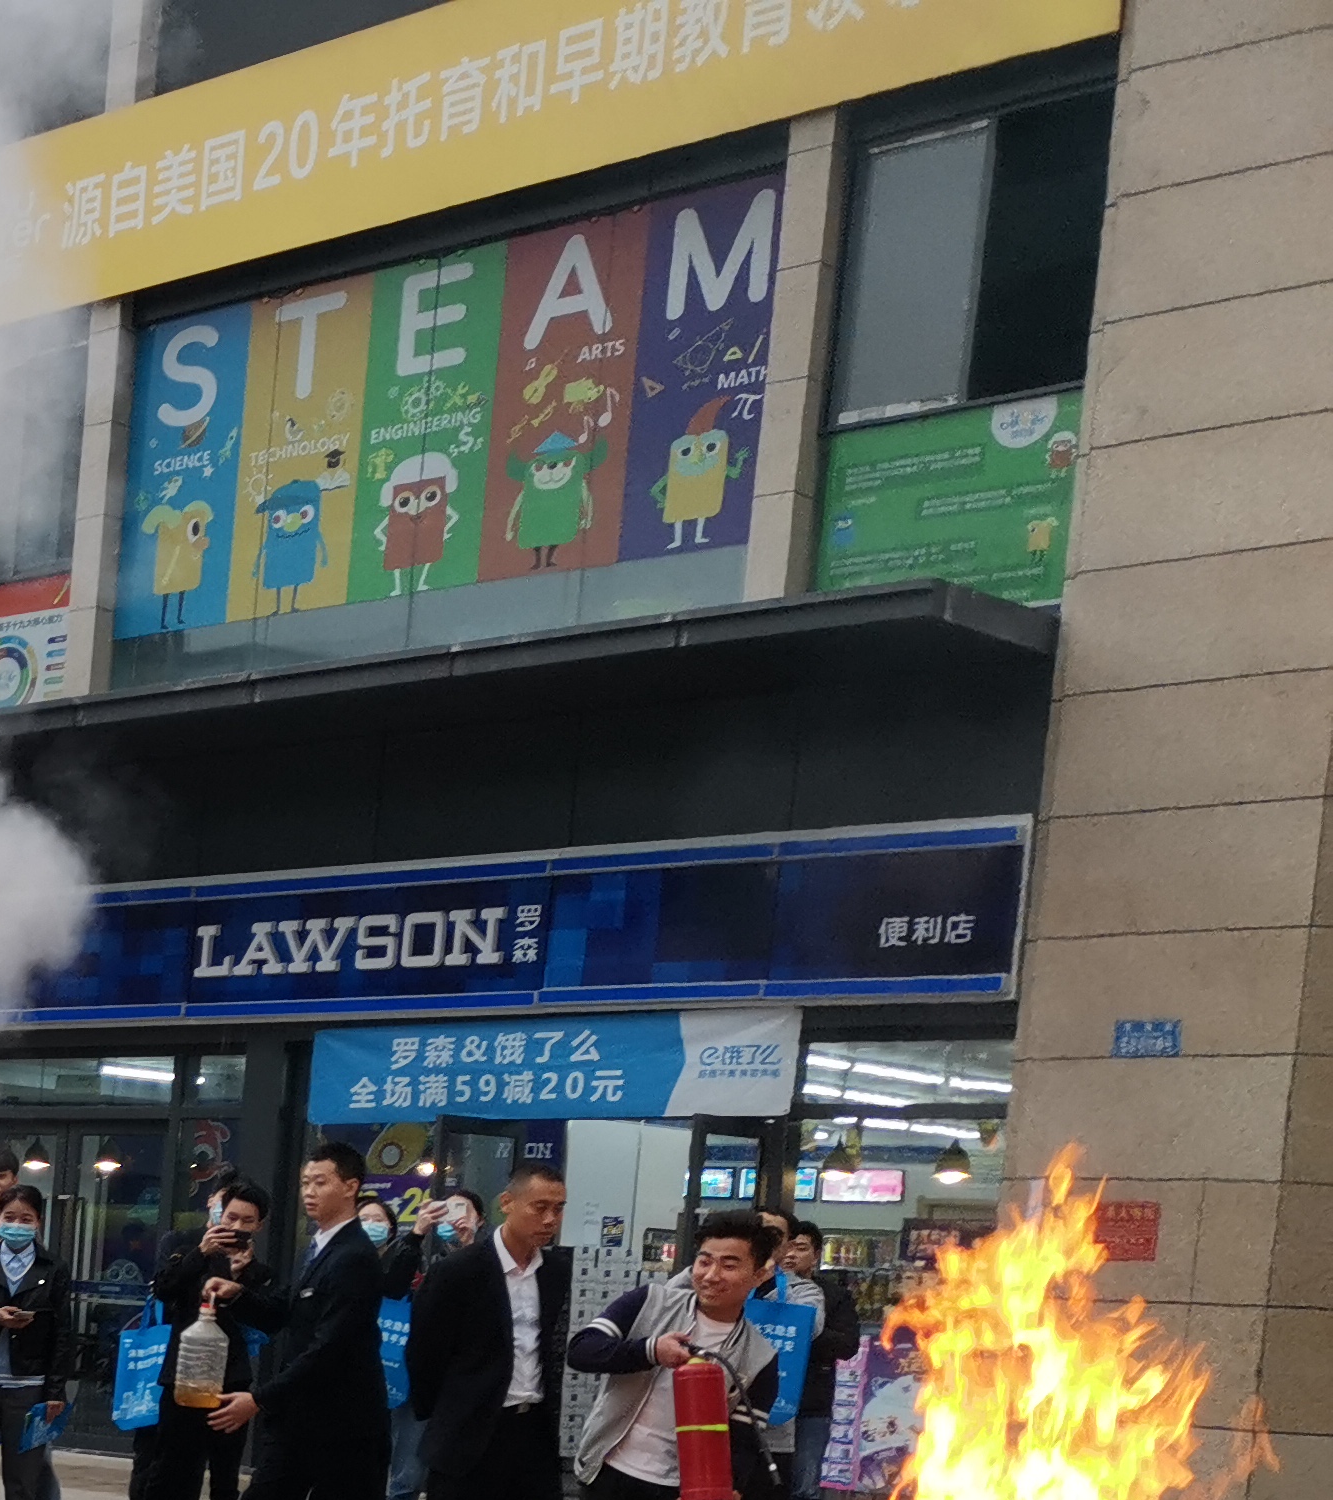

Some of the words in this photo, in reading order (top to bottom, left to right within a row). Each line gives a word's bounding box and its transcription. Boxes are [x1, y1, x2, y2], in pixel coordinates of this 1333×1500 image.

[157, 188, 777, 428] STEAM
[576, 338, 627, 364] ARTS
[369, 406, 485, 445] ENGINEERING
[153, 449, 213, 476] SCIENCE
[248, 432, 352, 467] TECHNOLOGY
[192, 905, 510, 978] LAWSON
[511, 904, 544, 964] 罗森
[877, 913, 976, 948] 便利店
[389, 1028, 602, 1070] 罗森&饿了么
[347, 1068, 626, 1111] 全场满59减20元
